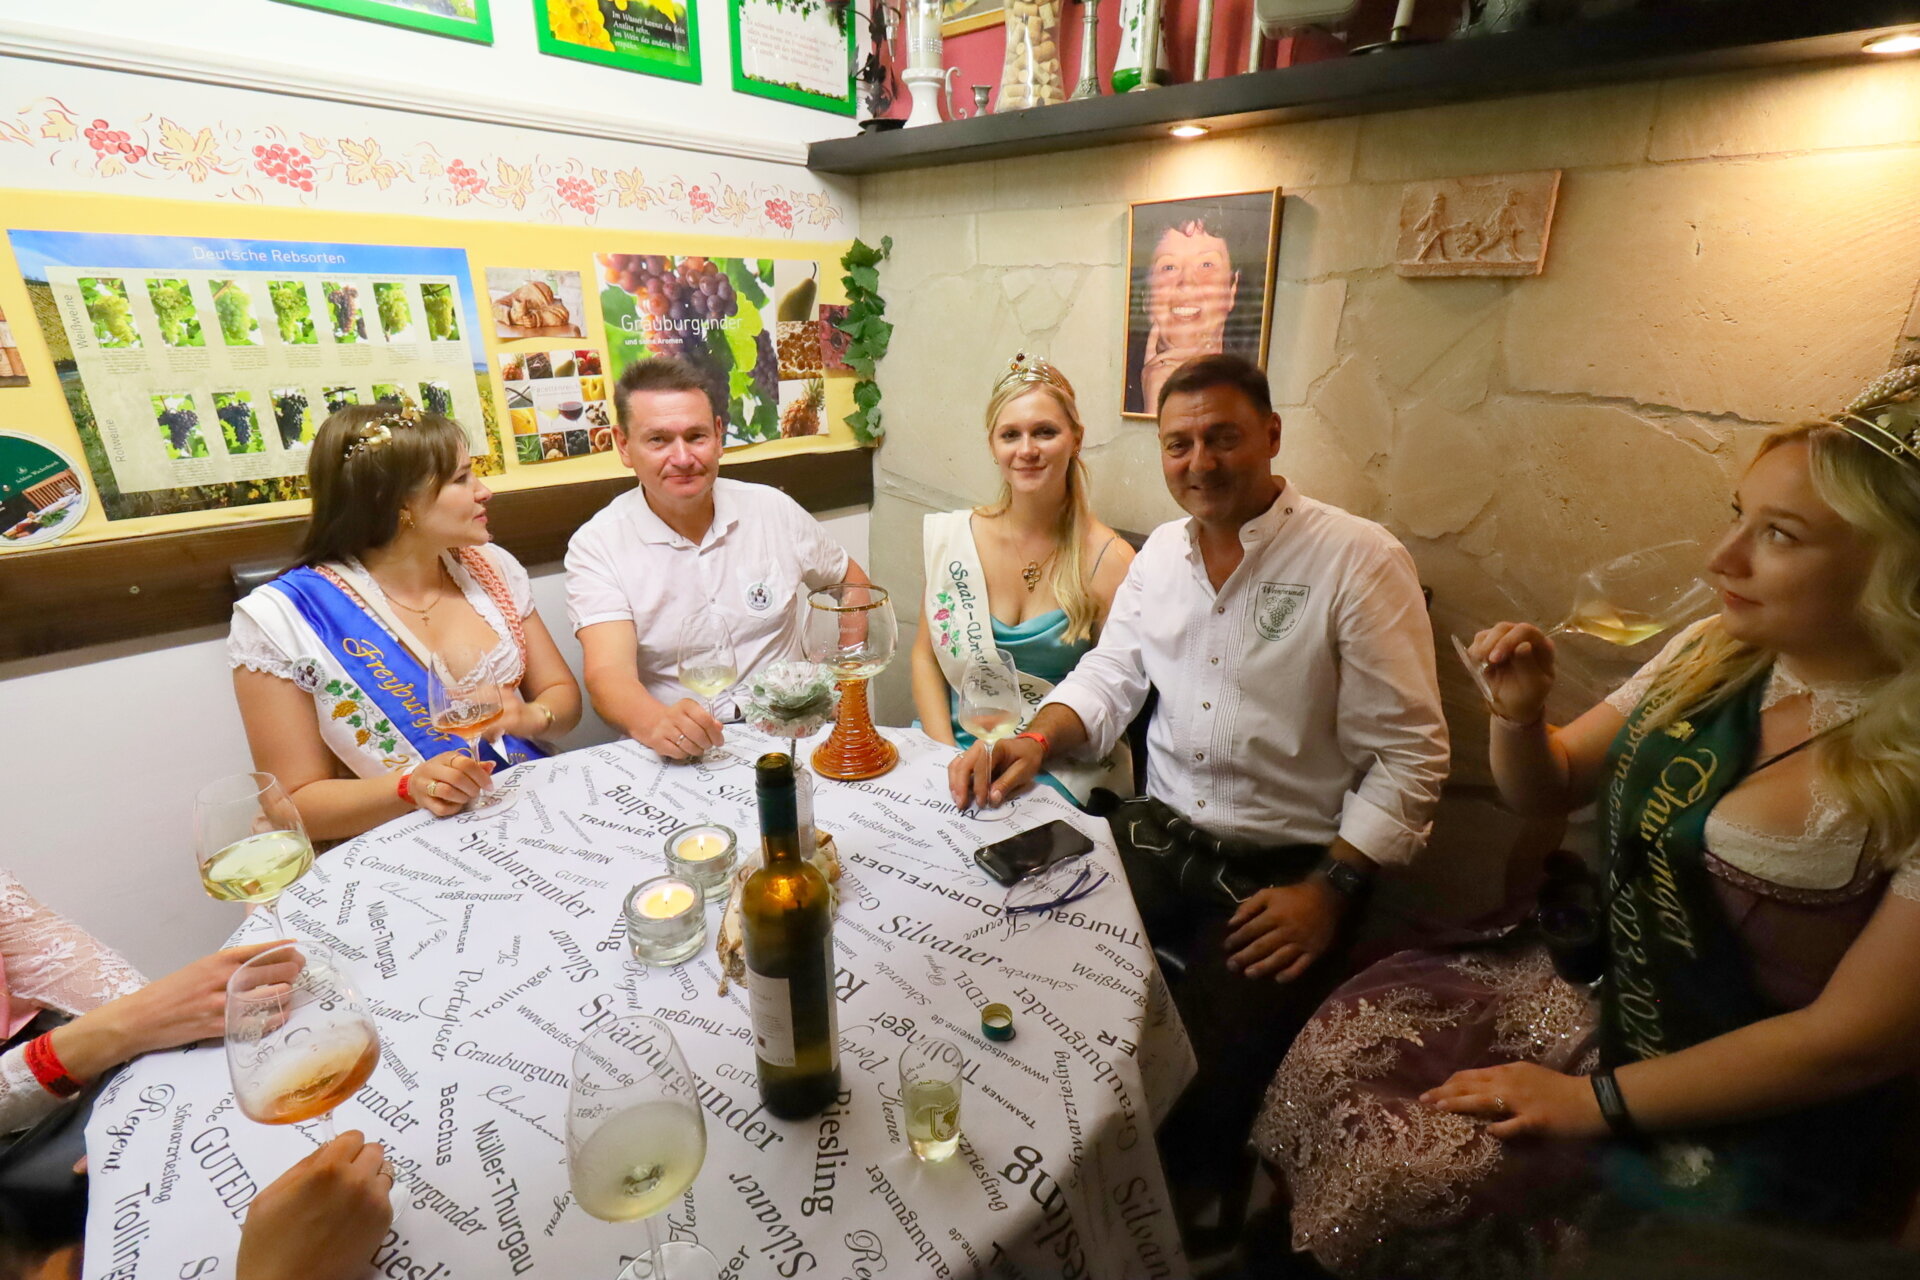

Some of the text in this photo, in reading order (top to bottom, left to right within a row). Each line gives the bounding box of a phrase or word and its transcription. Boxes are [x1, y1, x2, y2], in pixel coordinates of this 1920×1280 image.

[623, 31, 639, 41] Wein
[192, 246, 346, 265] Deutsche Rebsorten
[64, 294, 89, 349] Weißweine
[620, 314, 743, 336] Grauburgunder
[624, 338, 638, 346] und
[657, 336, 684, 345] Aromen
[108, 418, 126, 464] Rotweine
[341, 637, 452, 743] Freyburger
[578, 813, 655, 839] TRAMINER
[603, 784, 689, 837] Riesling
[848, 811, 935, 850] Weißburgunder
[873, 801, 917, 832] Bacchus
[360, 855, 465, 888] Grauburgunder
[411, 836, 493, 883] www.deutscheweine.de
[517, 836, 614, 865] Müller-Thurgau
[937, 829, 977, 869] TRAMINER
[435, 891, 525, 904] Lemberger
[459, 829, 596, 920] Spätburgunder
[555, 870, 609, 890] GUTEDEL
[849, 852, 1003, 918] DORNFELDER
[337, 880, 361, 926] Bacchus
[284, 910, 368, 963] Weißburgunder
[366, 900, 398, 980] Müller-Thurgau
[456, 903, 475, 955] DORNFELDER
[832, 935, 858, 961] Lembe
[834, 912, 897, 954] Spätburgund
[878, 915, 1004, 967] Silvaner
[1038, 907, 1142, 950] Thurgau
[549, 929, 599, 983] Silvaner
[1095, 943, 1150, 988] acchus
[470, 965, 553, 1020] Trollinger
[616, 960, 649, 1010] Regent
[953, 970, 990, 1012] EDEL
[1071, 962, 1148, 1007] Weißburg
[364, 997, 420, 1024] ilvaner
[419, 967, 485, 1061] Portugieser
[653, 1006, 754, 1048] ler-Thurgau
[455, 1040, 569, 1090] Grauburgun
[931, 1013, 1051, 1084] www.deutscheweine.de
[1013, 986, 1138, 1150] Grauburgunder
[715, 1063, 760, 1090] GUTE
[100, 1083, 176, 1175] Regent
[436, 1082, 459, 1166] Bacchus
[980, 1083, 1036, 1130] TRAMINER
[151, 1102, 192, 1205] Schwarzriesling
[190, 1126, 258, 1224] GUTED
[801, 1089, 851, 1217] Riesling
[472, 1120, 534, 1277] Müller-Thurgau
[544, 1191, 573, 1237] egent
[865, 1163, 954, 1280] auburgunder
[729, 1172, 817, 1278] Silvaner
[1113, 1176, 1172, 1280] Silvan
